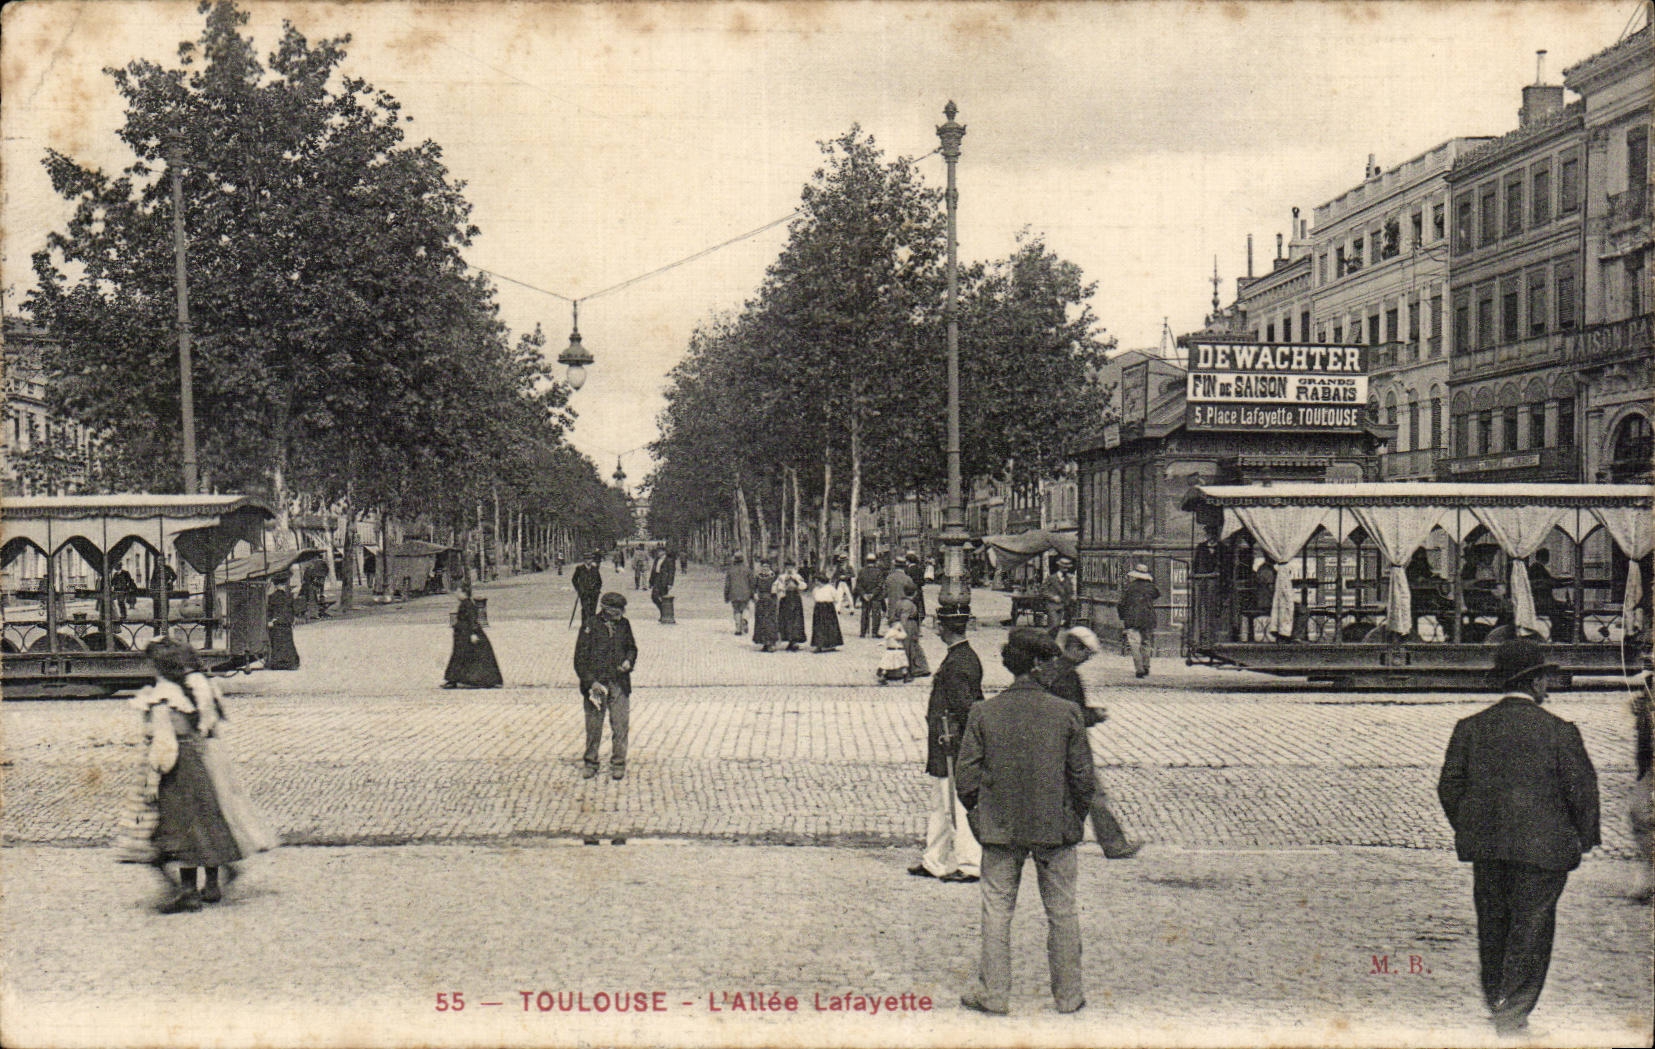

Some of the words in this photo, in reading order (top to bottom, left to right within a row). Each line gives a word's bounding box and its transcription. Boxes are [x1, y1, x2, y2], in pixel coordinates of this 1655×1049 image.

[1197, 345, 1361, 371] DEWACHTER
[1192, 375, 1217, 398] FIN
[1219, 382, 1232, 397] DE
[1234, 375, 1288, 399] SAISON
[1298, 378, 1356, 387] GRANDS
[1296, 387, 1357, 402] RABAIS
[1207, 406, 1237, 425] Place
[1298, 407, 1358, 427] TOULOUSE
